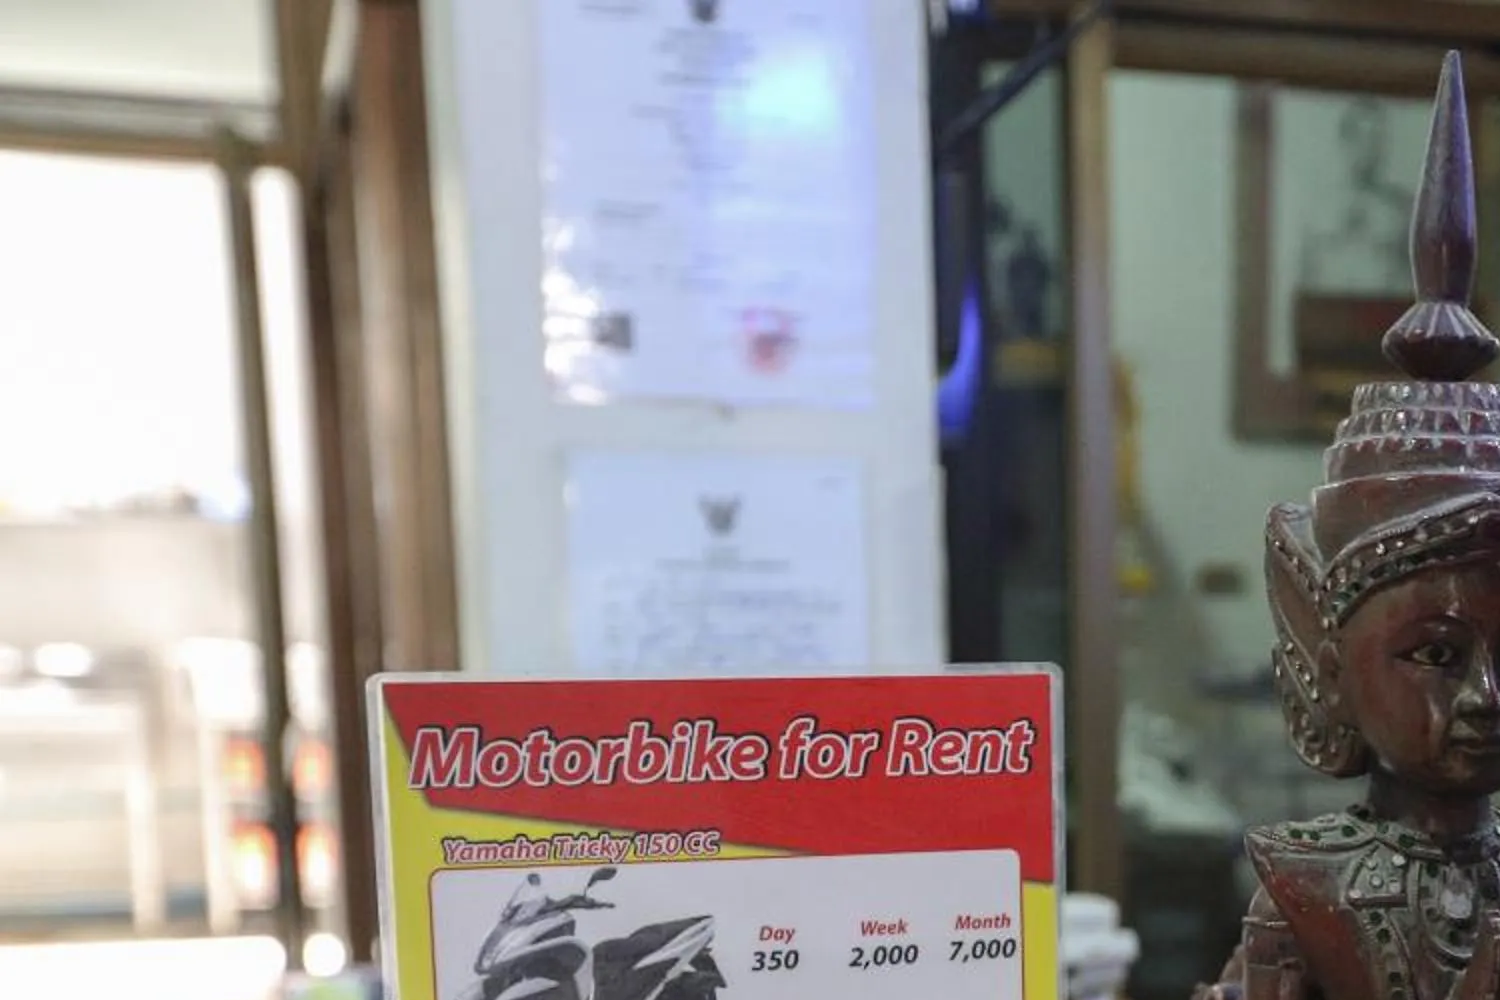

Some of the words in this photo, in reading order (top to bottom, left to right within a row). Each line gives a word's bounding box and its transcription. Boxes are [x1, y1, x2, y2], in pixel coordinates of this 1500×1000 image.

[409, 720, 768, 789] Motorbike
[778, 718, 878, 781] for
[886, 717, 1035, 777] Rent
[442, 834, 549, 863] Yamaha
[553, 832, 629, 863] Tricky
[635, 831, 680, 858] 150
[759, 925, 796, 944] Day
[860, 919, 908, 937] Week
[955, 913, 1011, 931] Month
[752, 949, 799, 971] 350
[849, 944, 919, 970] 2,000
[949, 938, 1016, 963] 7,000
